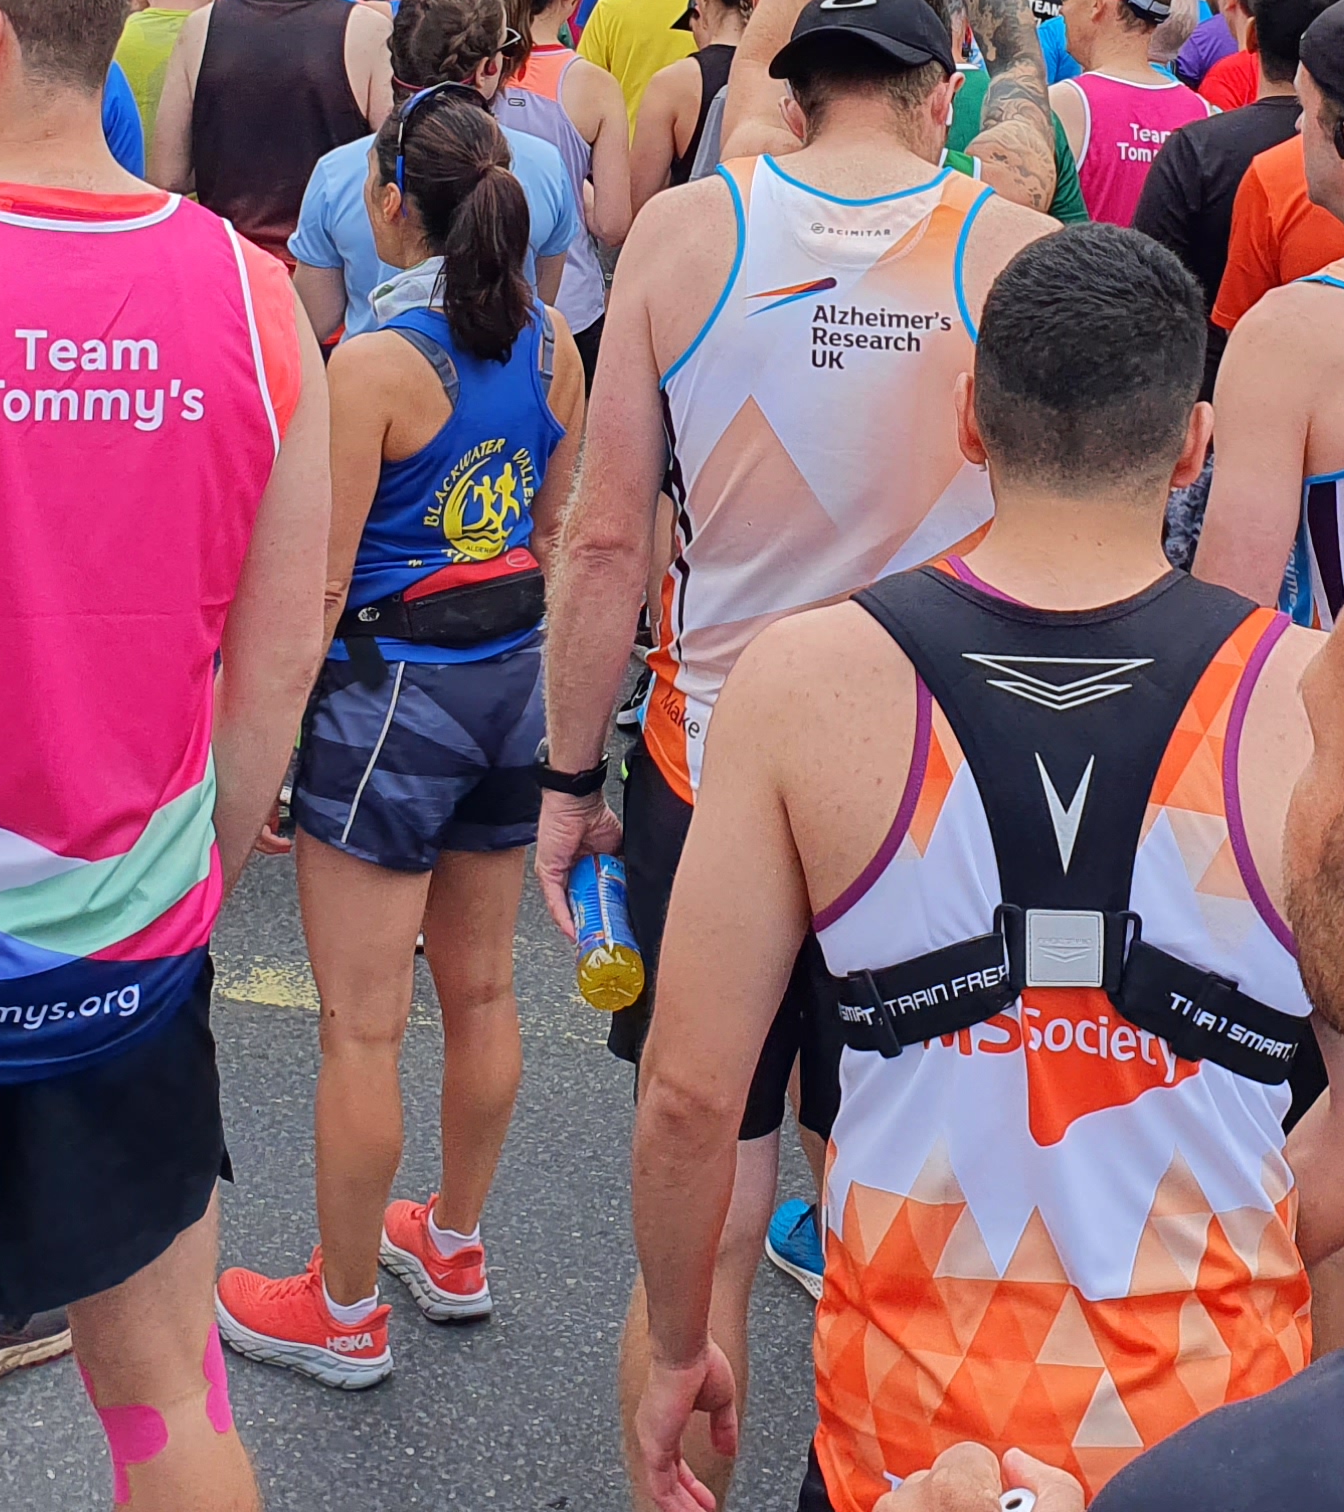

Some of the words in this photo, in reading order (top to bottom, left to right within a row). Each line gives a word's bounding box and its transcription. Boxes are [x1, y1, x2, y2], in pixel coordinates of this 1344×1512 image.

[827, 227, 891, 236] SCIMITAR
[812, 304, 952, 332] Alzheimer's
[14, 328, 159, 372] Team
[811, 326, 921, 352] Research
[811, 349, 845, 370] UK
[423, 437, 507, 527] BLACKWATER
[512, 447, 534, 507] VALLEY
[659, 691, 702, 740] Make
[883, 983, 949, 1018] TRAIN
[1024, 1006, 1178, 1084] Society
[325, 1332, 374, 1353] HOKA
